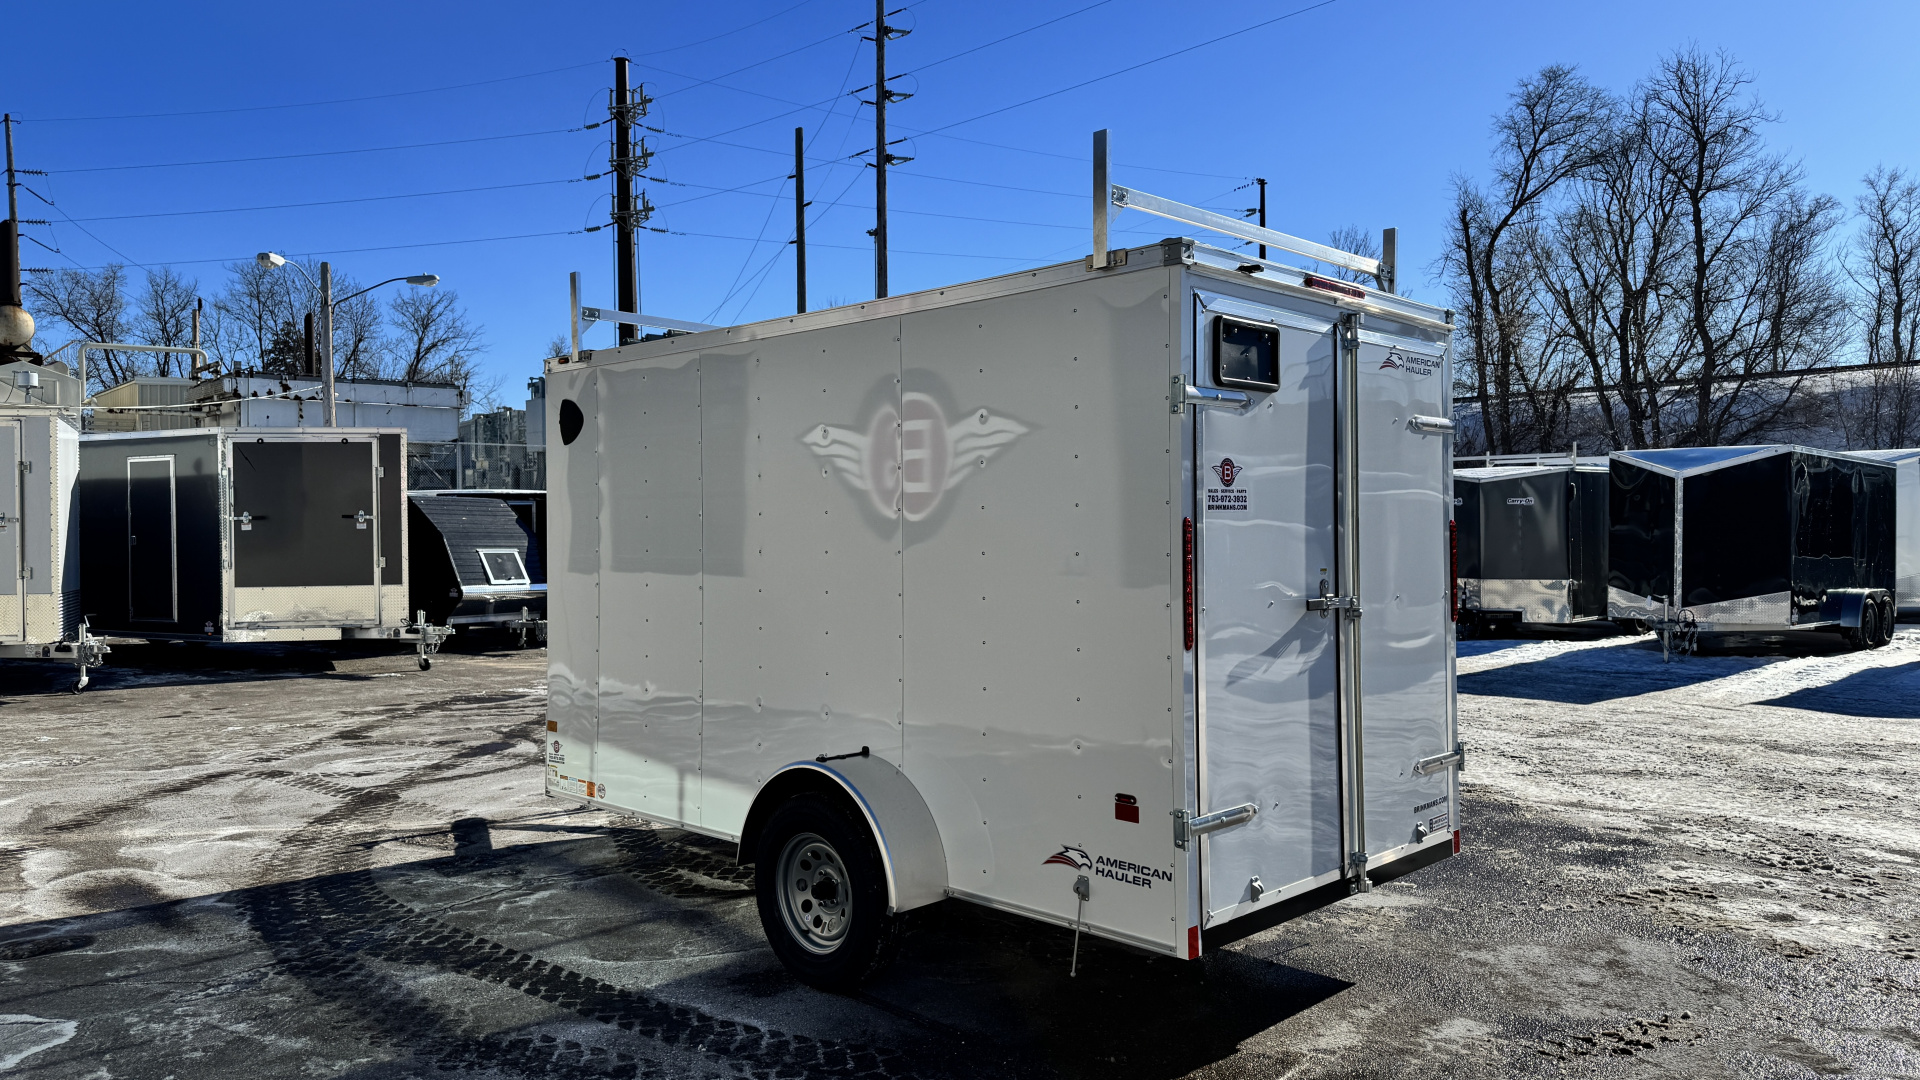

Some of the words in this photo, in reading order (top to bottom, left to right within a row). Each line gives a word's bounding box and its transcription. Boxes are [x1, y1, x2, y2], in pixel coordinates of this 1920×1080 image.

[1406, 356, 1440, 368] AMERICAN
[1406, 366, 1432, 376] HAULER
[1224, 465, 1232, 480] B
[1095, 855, 1173, 882] AMERICAN
[1095, 866, 1152, 889] HAULER
